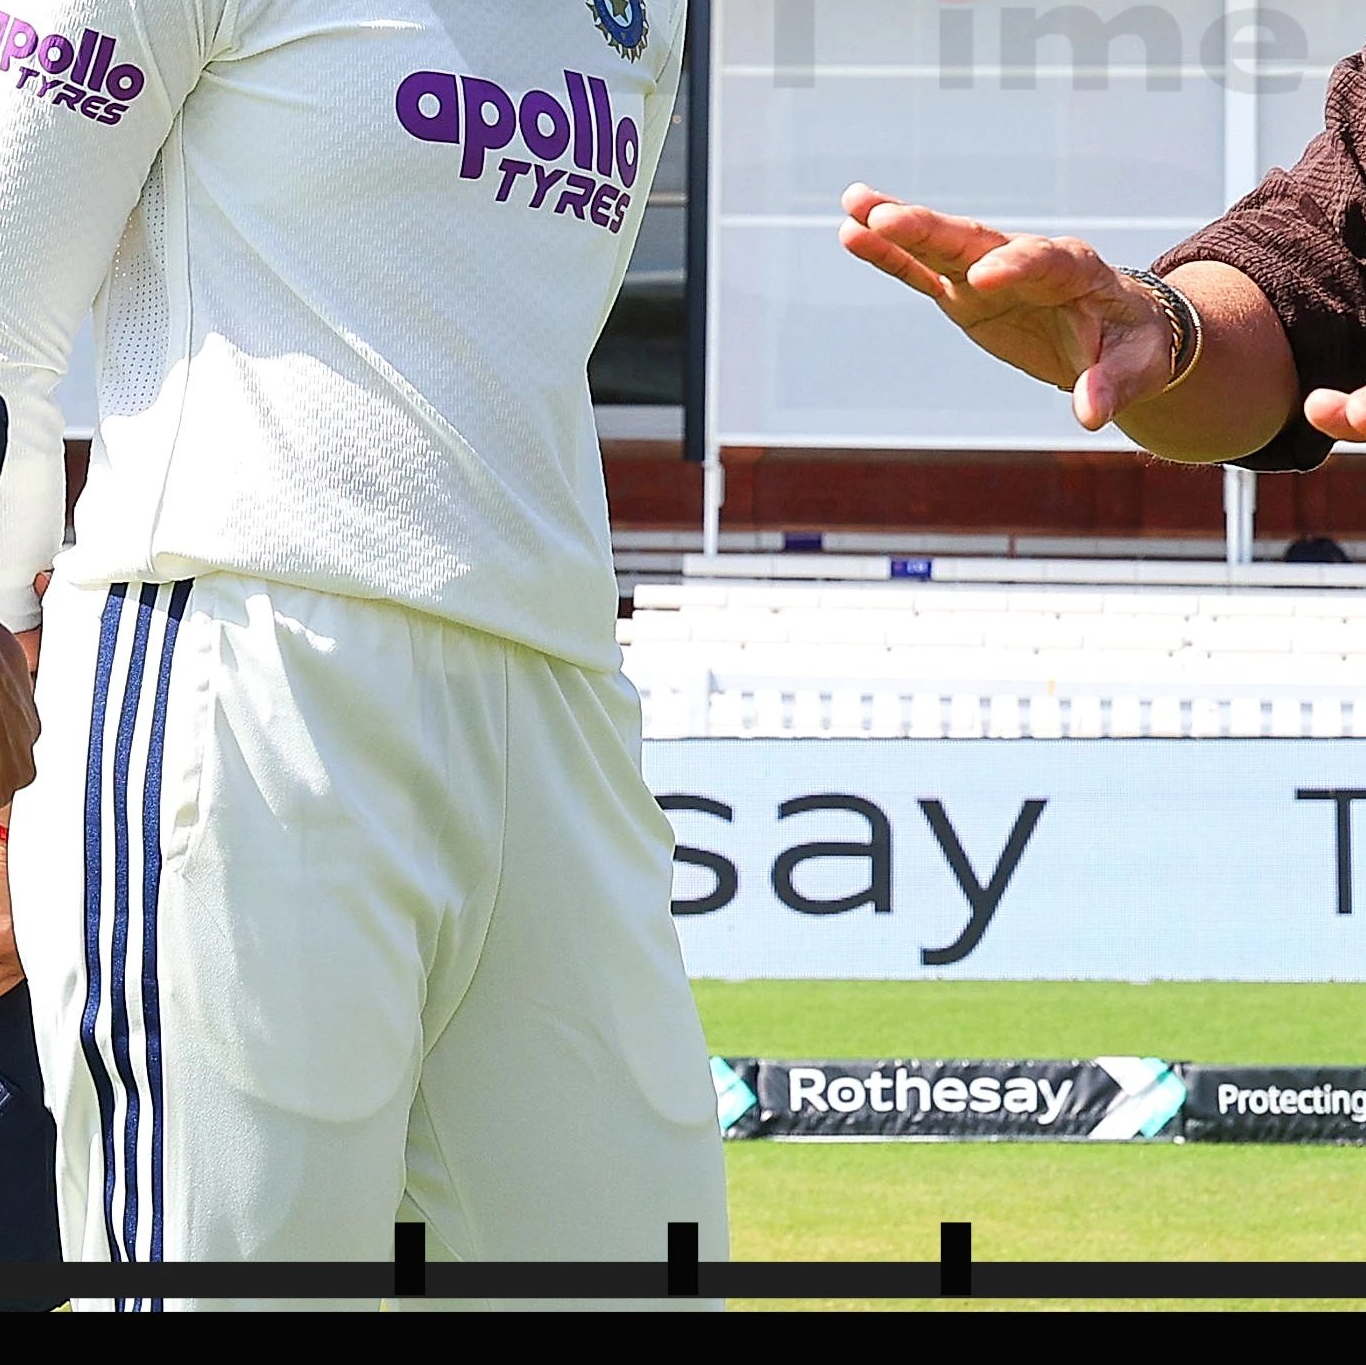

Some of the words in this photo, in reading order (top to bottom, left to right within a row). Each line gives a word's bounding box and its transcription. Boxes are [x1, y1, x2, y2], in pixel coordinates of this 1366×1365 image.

[16, 66, 130, 126] TYRES
[395, 69, 639, 189] apollo
[495, 157, 632, 234] TYRES
[788, 1066, 1074, 1126] Rothesay
